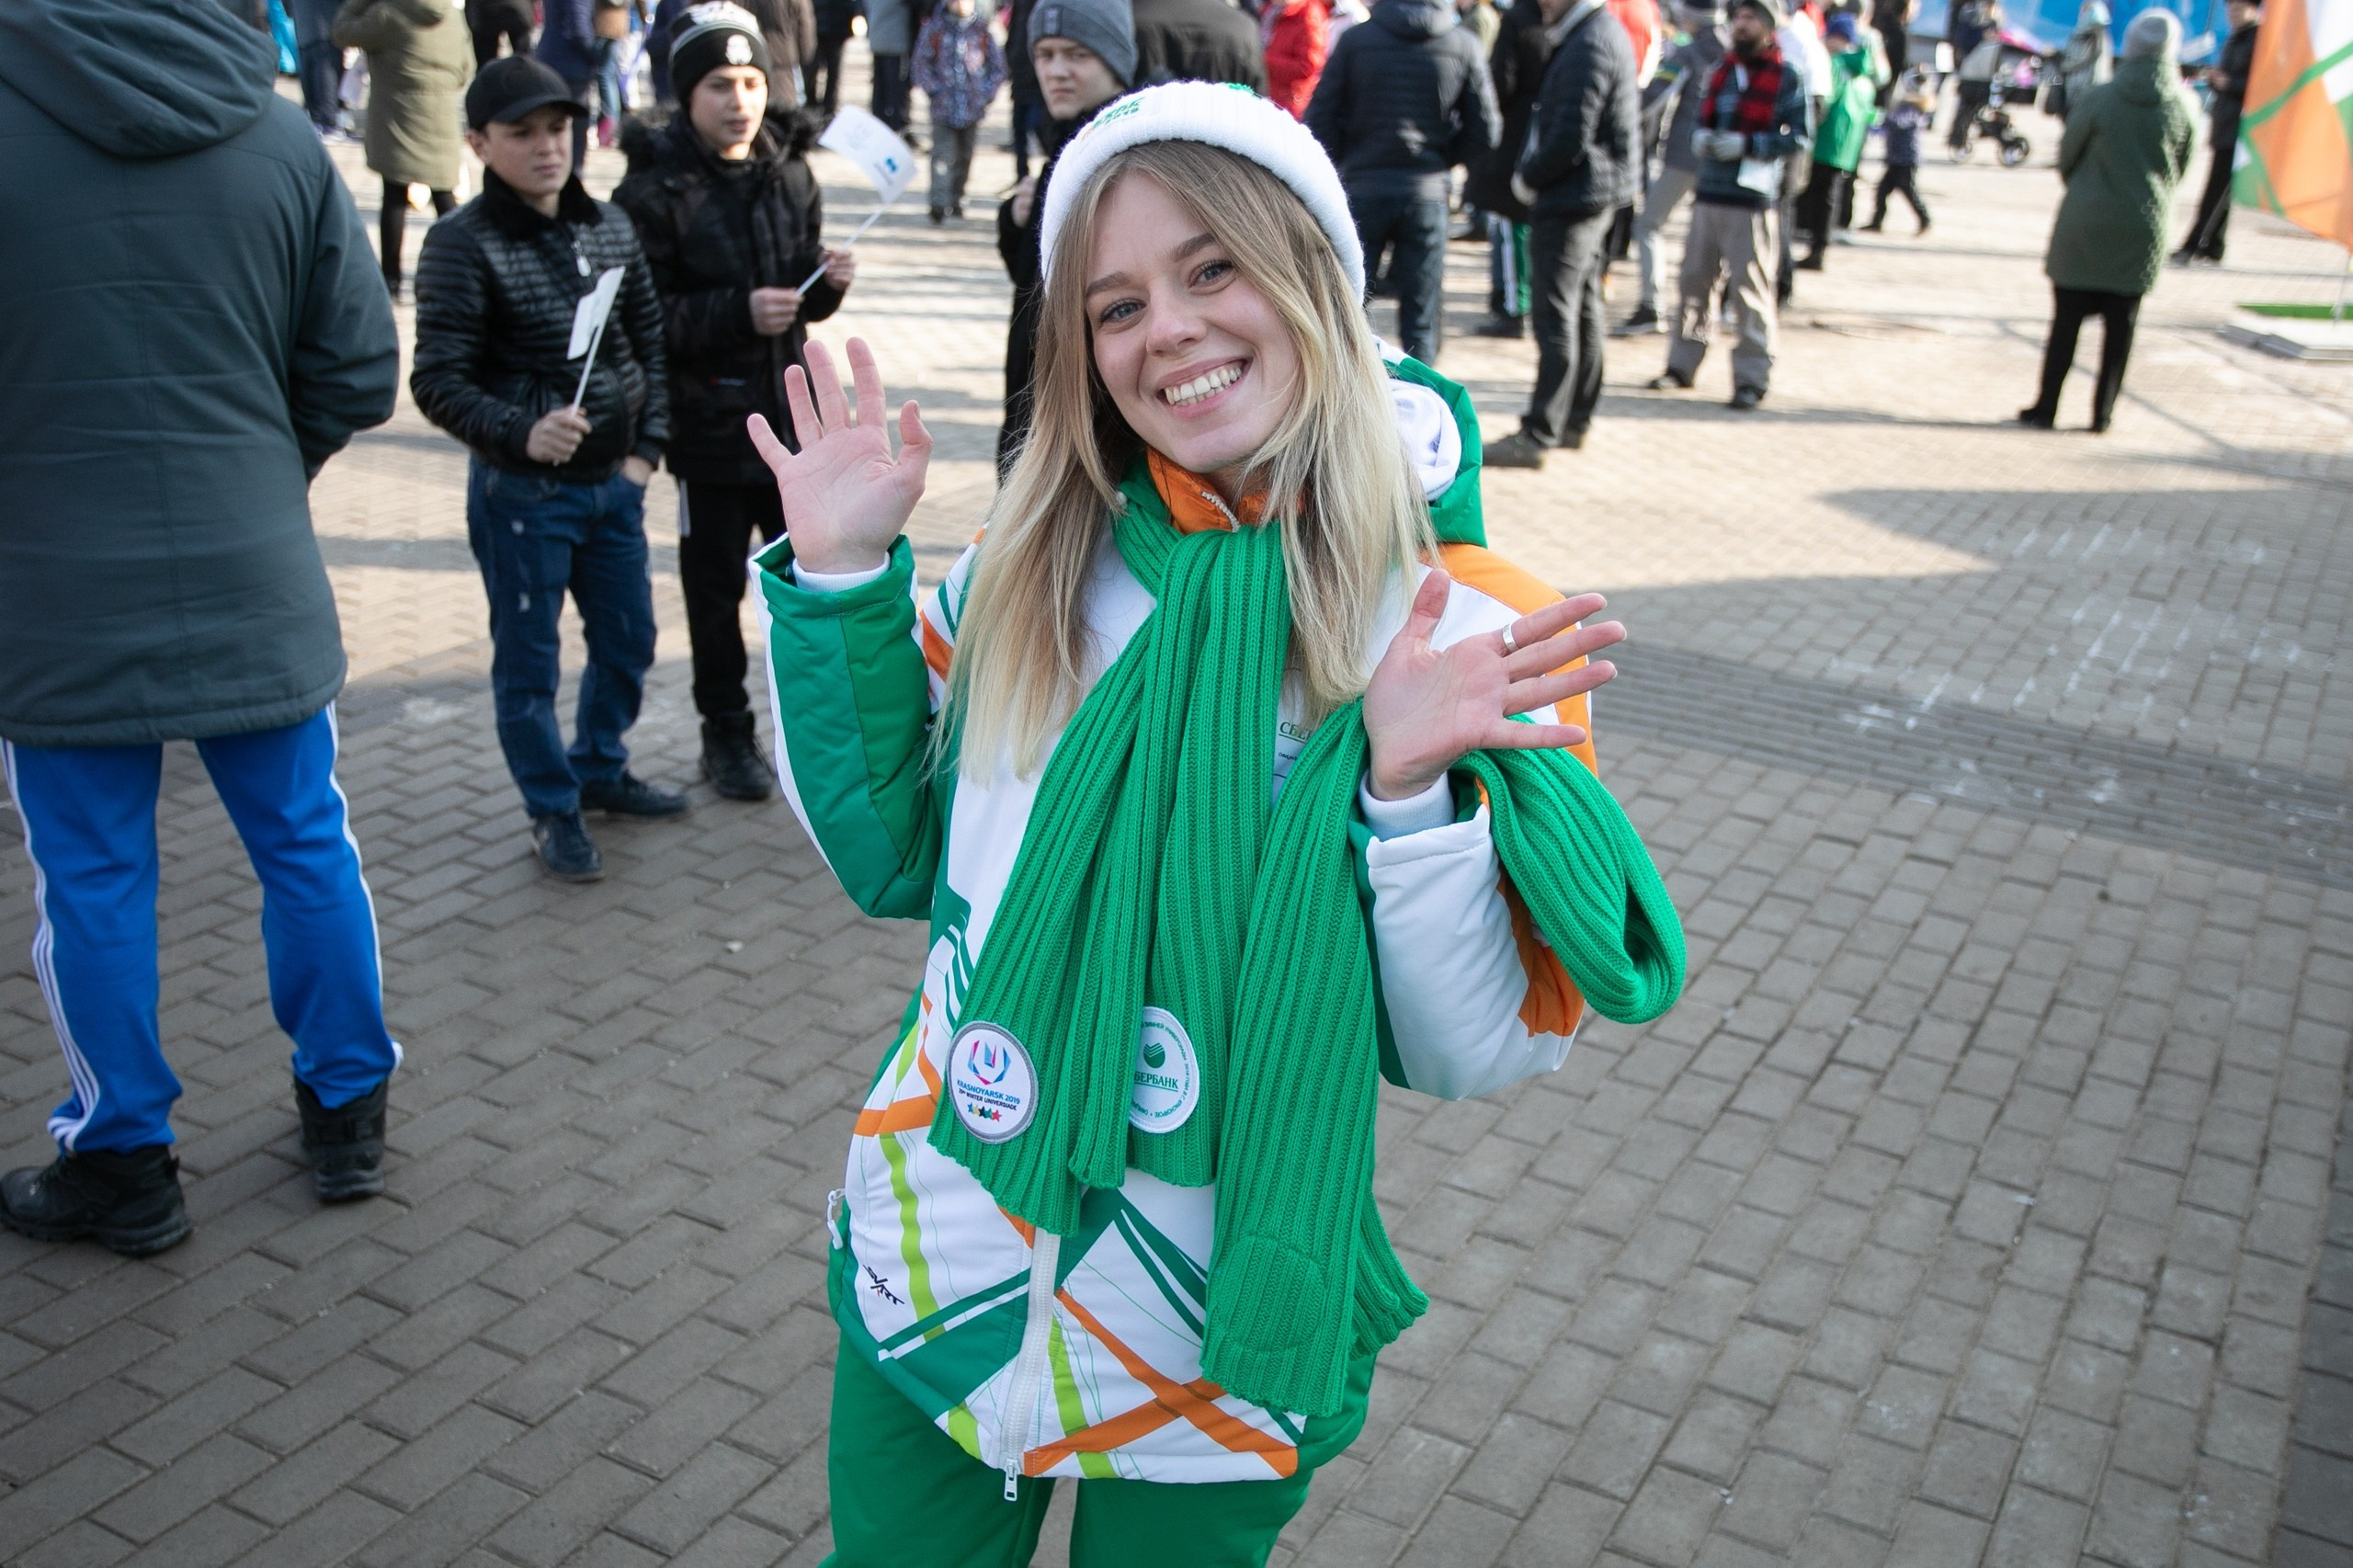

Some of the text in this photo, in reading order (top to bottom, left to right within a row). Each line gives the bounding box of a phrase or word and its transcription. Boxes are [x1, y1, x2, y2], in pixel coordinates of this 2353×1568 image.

[1134, 1071, 1178, 1089] БЕРБАНК
[957, 1079, 1020, 1105] KRASNOYARSK 2019
[966, 1092, 983, 1102] WINTER
[983, 1096, 1017, 1110] UNIVERSIADE
